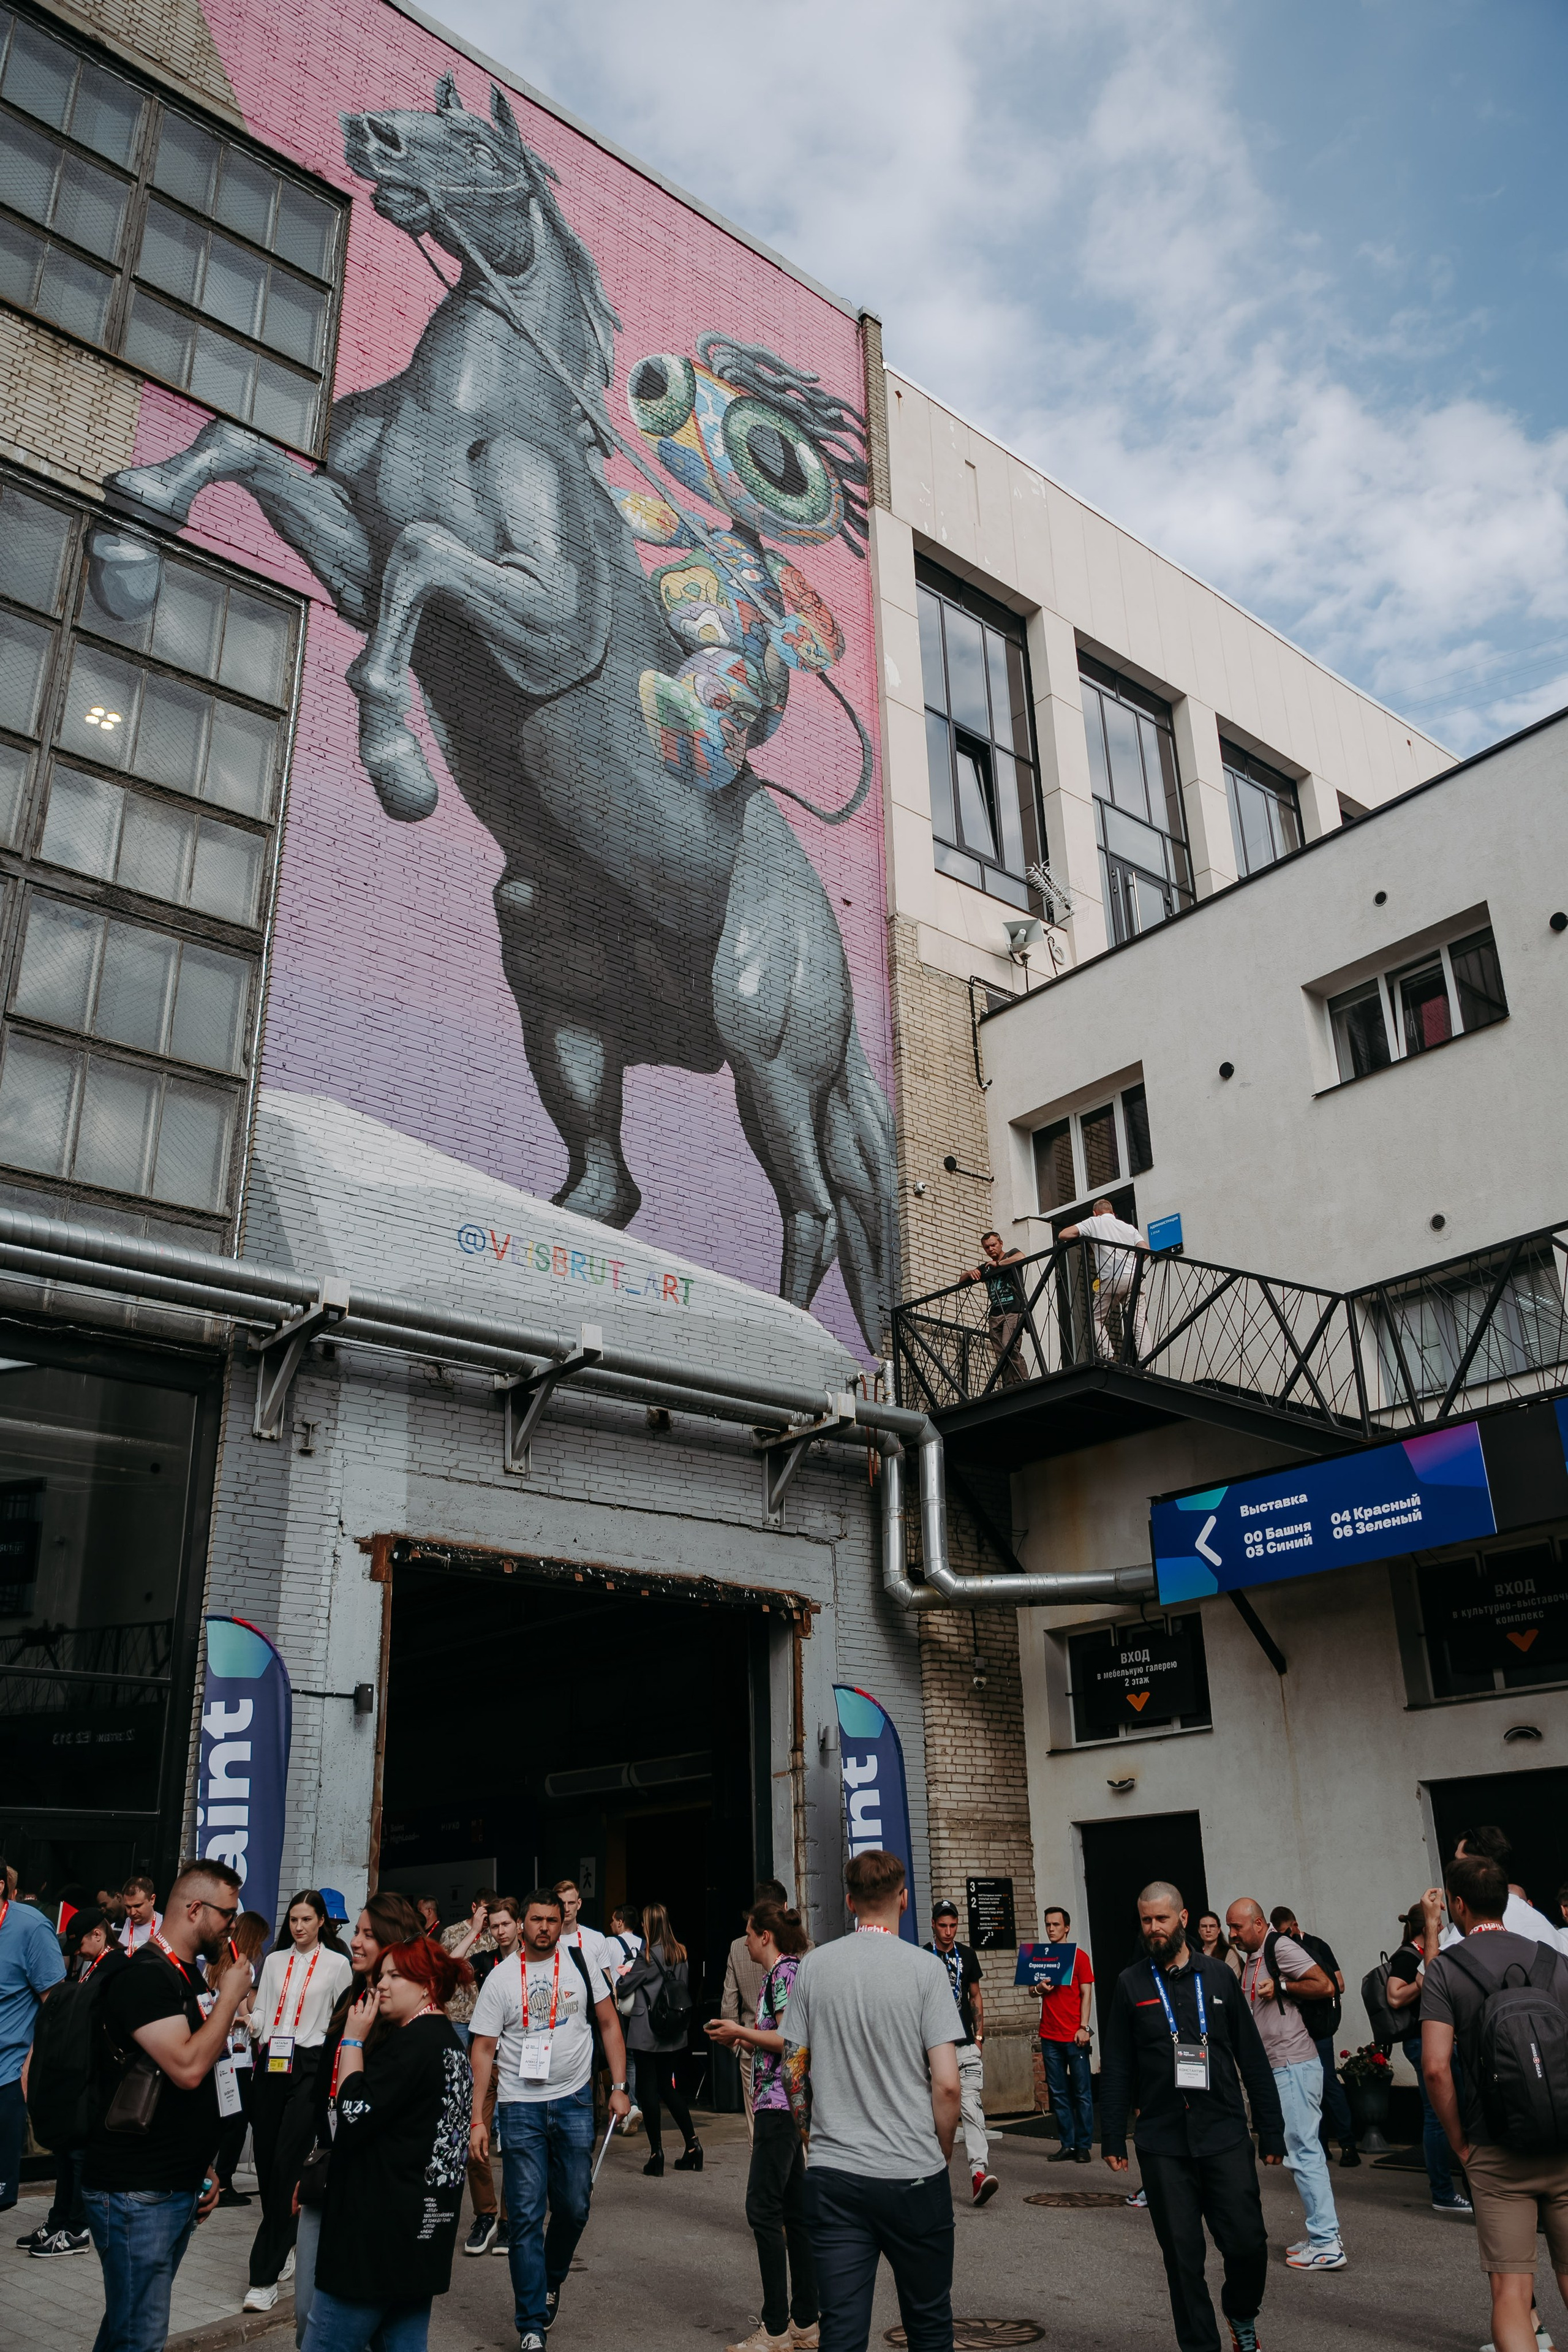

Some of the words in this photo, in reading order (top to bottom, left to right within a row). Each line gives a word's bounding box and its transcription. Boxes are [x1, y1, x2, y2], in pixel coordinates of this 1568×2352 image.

[458, 1223, 695, 1306] @VEISBRUT_ART
[1240, 1493, 1308, 1517] Выставка
[1330, 1510, 1351, 1525] 04
[1354, 1493, 1421, 1520] Красный
[1244, 1531, 1263, 1544] 00
[1265, 1521, 1312, 1541] Башня
[1333, 1525, 1354, 1539] 06
[1355, 1508, 1423, 1535] Зеленый
[1246, 1544, 1264, 1559] 03
[1266, 1534, 1313, 1554] Синий
[1494, 1578, 1536, 1597] ВХОД
[1452, 1610, 1458, 1619] в
[1496, 1610, 1545, 1625] комплекс
[1120, 1648, 1150, 1664] ВХОД
[1103, 1665, 1144, 1679] мебельную
[1146, 1660, 1177, 1672] галерею
[1125, 1678, 1129, 1687] 2
[1132, 1676, 1150, 1686] этаж
[202, 1698, 254, 1896] aint
[970, 1881, 976, 1893] 3
[971, 1897, 977, 1908] 2
